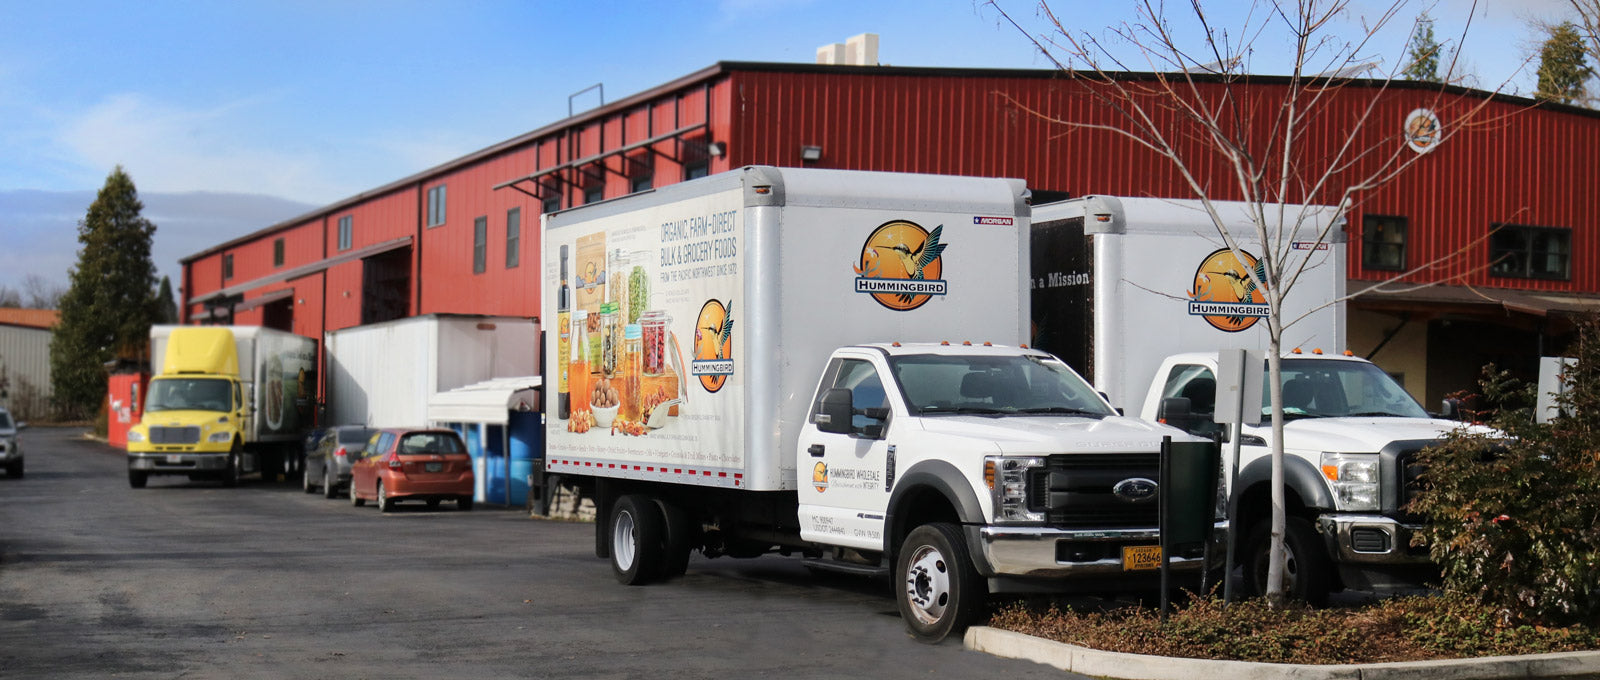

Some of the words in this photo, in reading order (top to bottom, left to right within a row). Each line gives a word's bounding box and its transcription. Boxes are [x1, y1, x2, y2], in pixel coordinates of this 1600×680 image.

[980, 217, 1012, 225] MORGAN
[660, 219, 689, 243] ORGANIC,
[660, 246, 676, 267] BULK
[677, 245, 682, 264] &
[683, 240, 713, 264] GROCERY
[714, 236, 737, 260] FOODS
[660, 272, 670, 283] FROM
[678, 268, 692, 281] PACIFIC
[692, 265, 716, 279] NORTHWEST
[716, 263, 727, 276] SINCE
[1030, 278, 1036, 289] n
[1038, 277, 1045, 289] a
[1048, 270, 1090, 288] Mission
[859, 280, 944, 292] HUMMINGBIRD
[1192, 304, 1270, 315] HUMMINGBIRD
[693, 361, 733, 373] HUMMINGBIRD
[830, 468, 855, 479] HUMMINGBIRD
[856, 469, 880, 481] WHOLESALE
[1133, 552, 1161, 563] 123646
